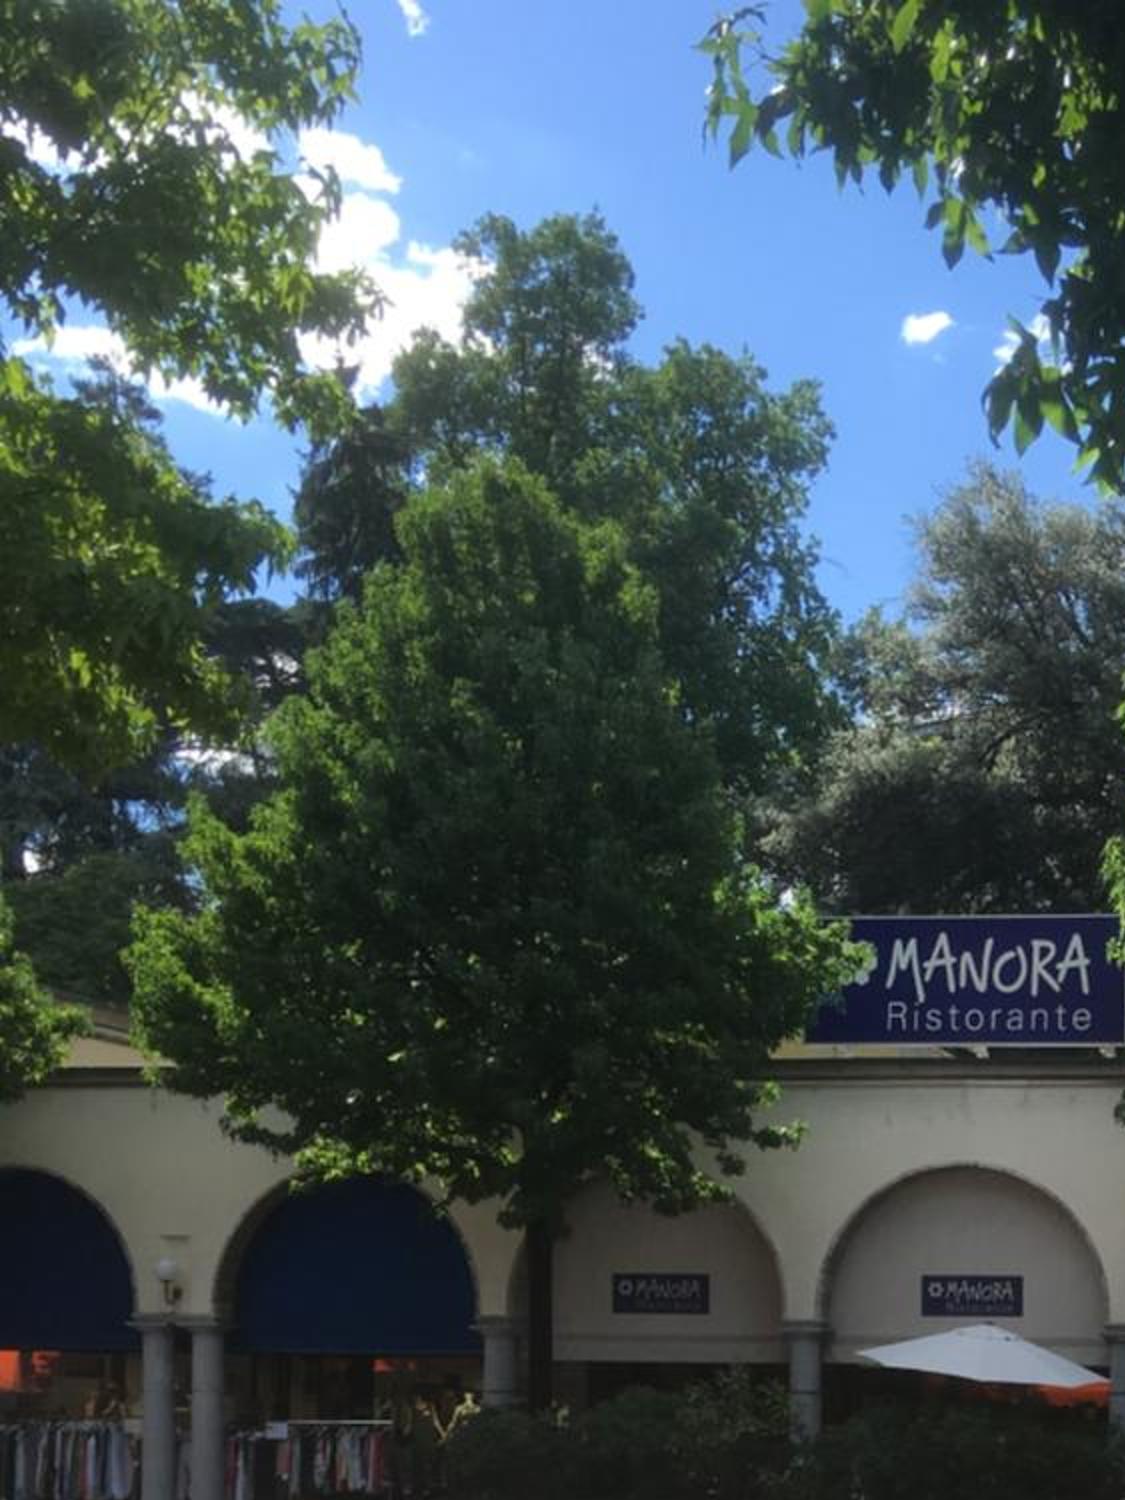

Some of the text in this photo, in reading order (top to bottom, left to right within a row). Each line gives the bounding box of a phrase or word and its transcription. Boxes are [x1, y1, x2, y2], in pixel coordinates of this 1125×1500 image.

[886, 932, 1091, 1003] MANORA
[886, 1002, 1092, 1032] Ristorante
[635, 1279, 701, 1300] MANORA
[945, 1280, 1015, 1302] MANORA
